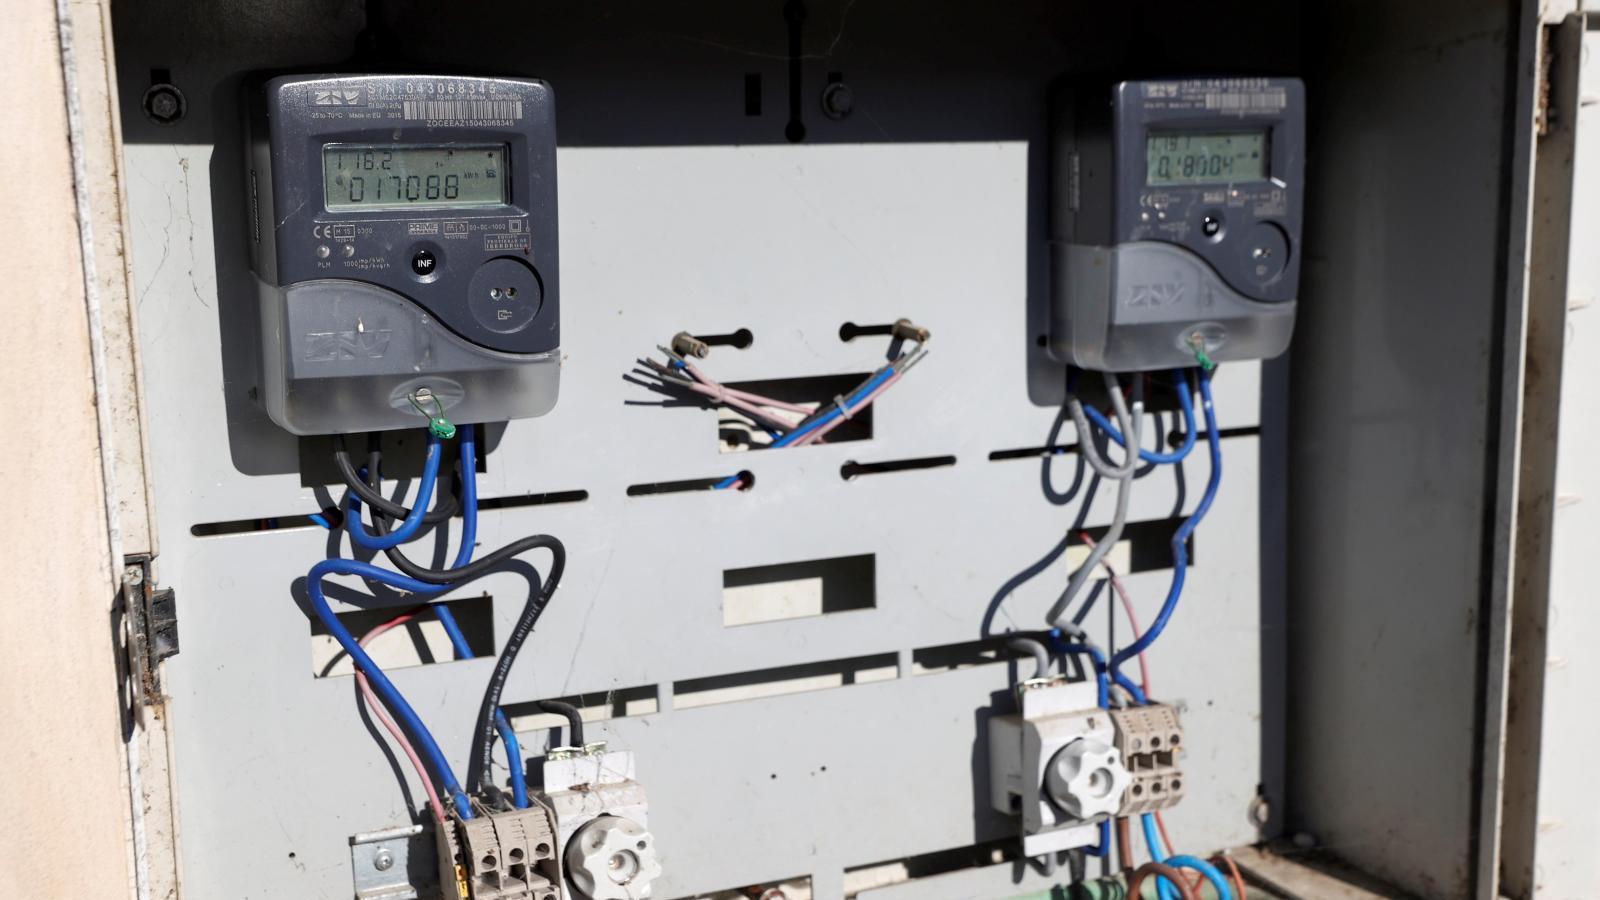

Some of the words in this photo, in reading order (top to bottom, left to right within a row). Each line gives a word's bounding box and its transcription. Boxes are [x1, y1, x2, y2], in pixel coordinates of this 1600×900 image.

[407, 81, 496, 94] 043068345
[350, 174, 460, 203] 017088
[417, 259, 433, 268] INF
